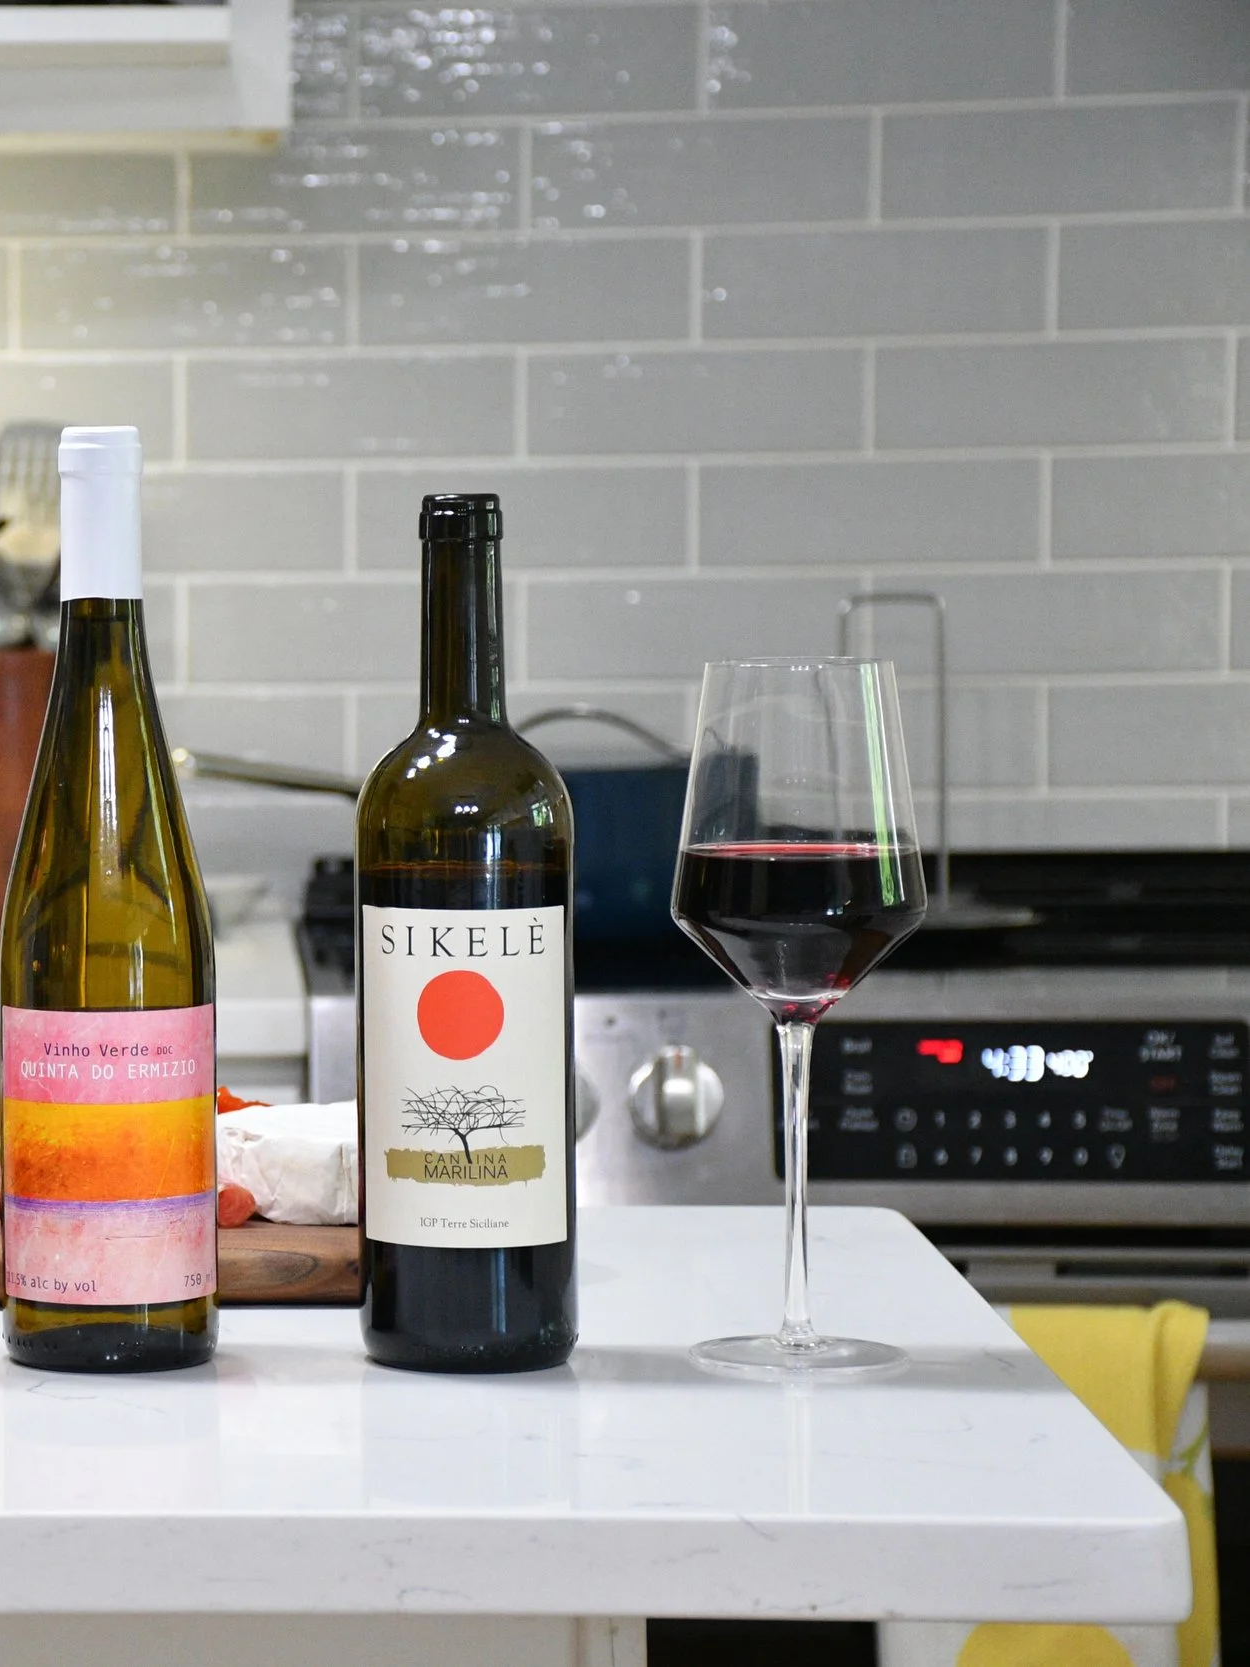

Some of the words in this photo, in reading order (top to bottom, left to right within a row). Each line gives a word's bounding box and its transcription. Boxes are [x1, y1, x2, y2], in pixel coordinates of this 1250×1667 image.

[381, 917, 546, 957] SIKELÈ
[44, 1042, 90, 1057] Vinho
[99, 1043, 149, 1057] Verde
[156, 1045, 174, 1055] DOC
[21, 1060, 79, 1080] QUINTA
[92, 1064, 115, 1080] DO
[128, 1059, 196, 1079] ERMIZIO
[424, 1165, 508, 1179] MARILINA
[420, 1217, 438, 1227] IGP
[440, 1218, 467, 1228] Terre
[469, 1218, 510, 1228] Siciliane
[31, 1276, 48, 1289] alc
[54, 1279, 68, 1293] by
[74, 1280, 97, 1292] vol
[183, 1273, 201, 1287] 750
